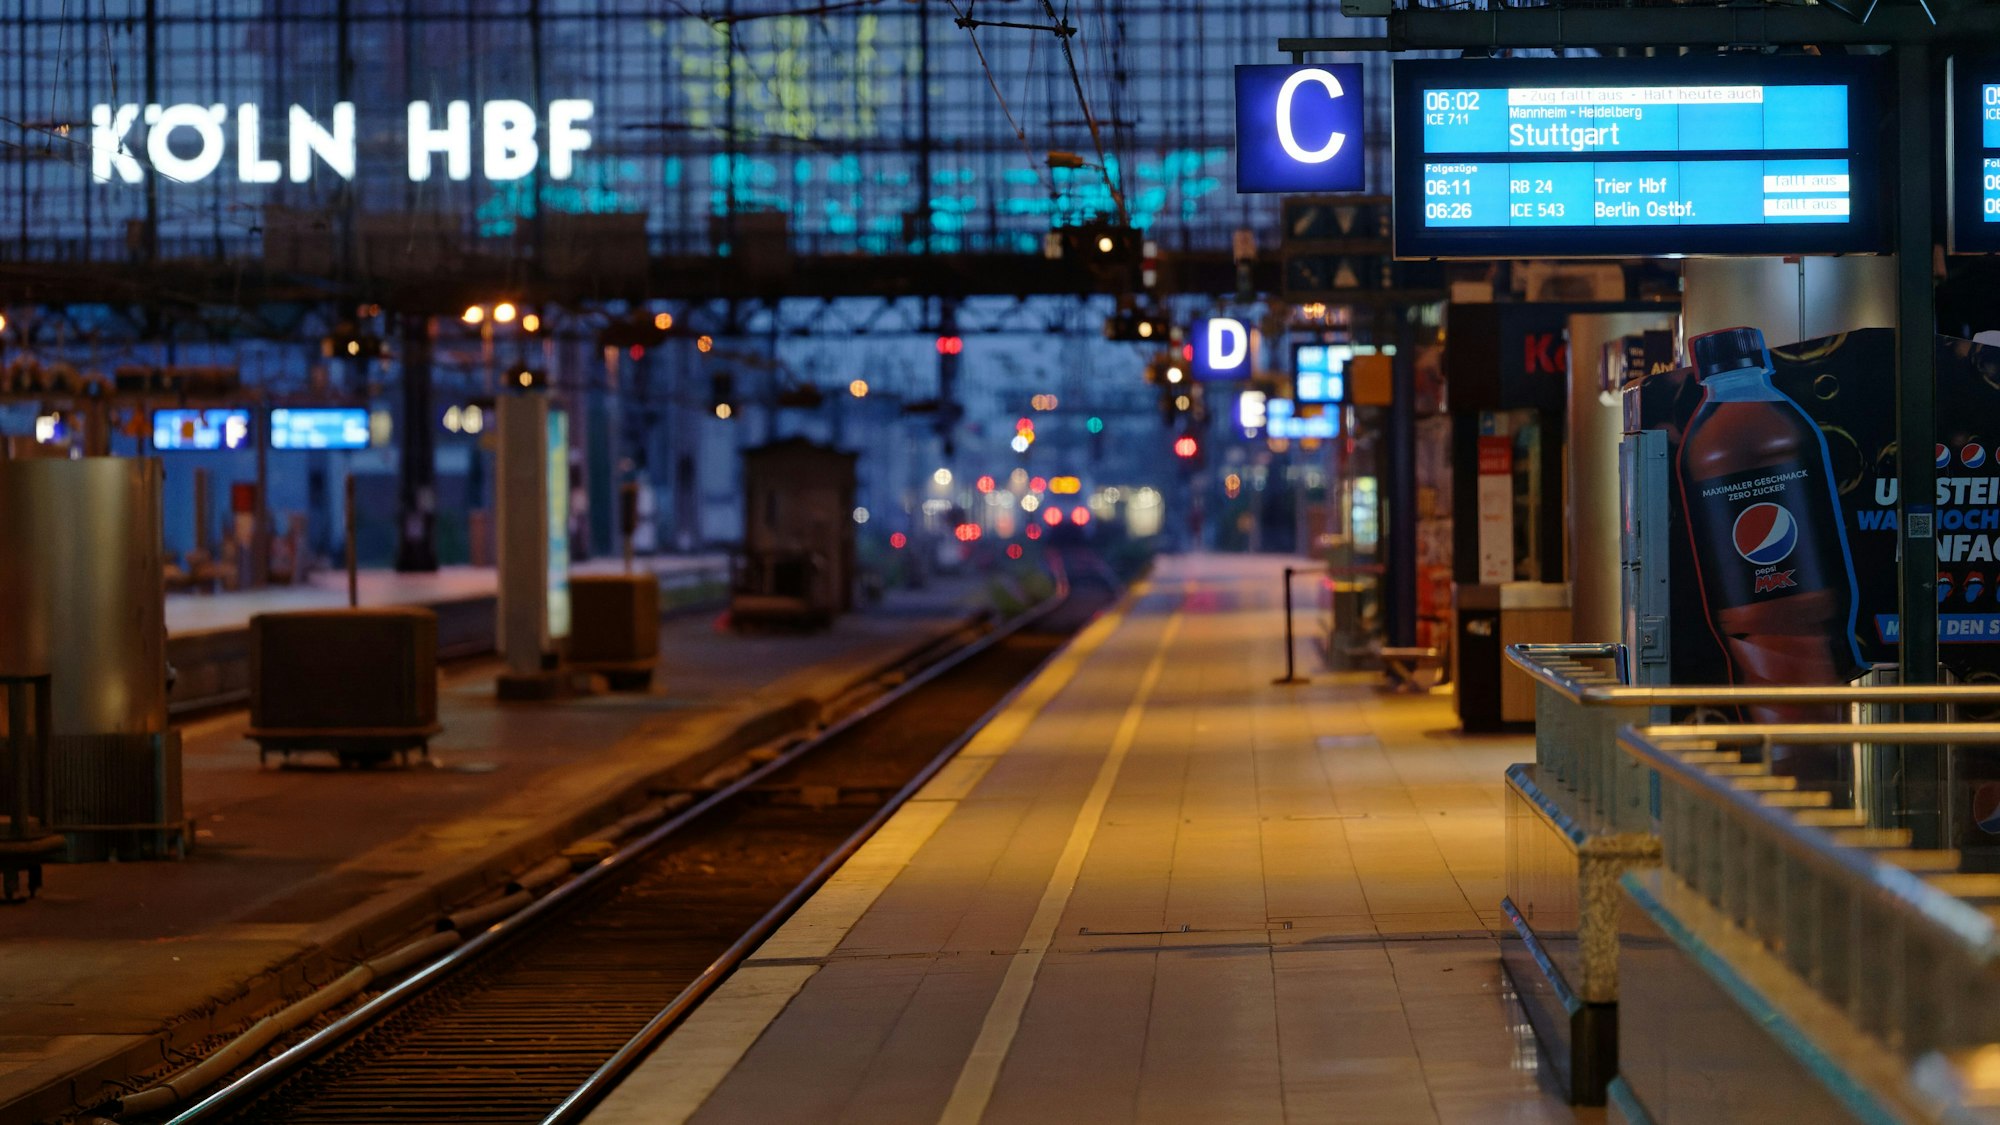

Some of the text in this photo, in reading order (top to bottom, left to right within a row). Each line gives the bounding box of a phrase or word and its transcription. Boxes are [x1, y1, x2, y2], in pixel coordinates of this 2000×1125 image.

[1426, 92, 1480, 111] 06:02
[1530, 90, 1556, 103] Zug
[1598, 91, 1623, 100] aus
[1644, 89, 1673, 100] Halt
[1679, 89, 1723, 99] heute
[1727, 88, 1761, 99] auch
[1276, 68, 1346, 164] C
[1426, 113, 1469, 125] ICE 711
[1509, 107, 1567, 118] Mannheim
[1578, 105, 1643, 121] Heidelberg
[91, 99, 594, 184] KÖLN HBF
[1509, 122, 1620, 151] Stuttgart
[1425, 164, 1478, 174] Folgezüge
[1425, 179, 1471, 195] 06:11
[1510, 180, 1553, 194] RB 24
[1595, 178, 1667, 193] Trier Hbf
[1812, 177, 1838, 186] aus
[1425, 203, 1472, 218] 06:26
[1510, 202, 1565, 217] ICE 543
[1595, 201, 1696, 217] Berlin Ostbf.
[1812, 200, 1838, 209] aus
[1208, 318, 1248, 370] D
[1240, 390, 1267, 428] E
[1702, 469, 1809, 497] MAXIMALER GESCHMACK
[1728, 483, 1786, 501] ZERO ZUCKER
[1754, 565, 1777, 576] pepsi
[1754, 568, 1798, 593] MAX
[1947, 619, 1984, 635] DEN
